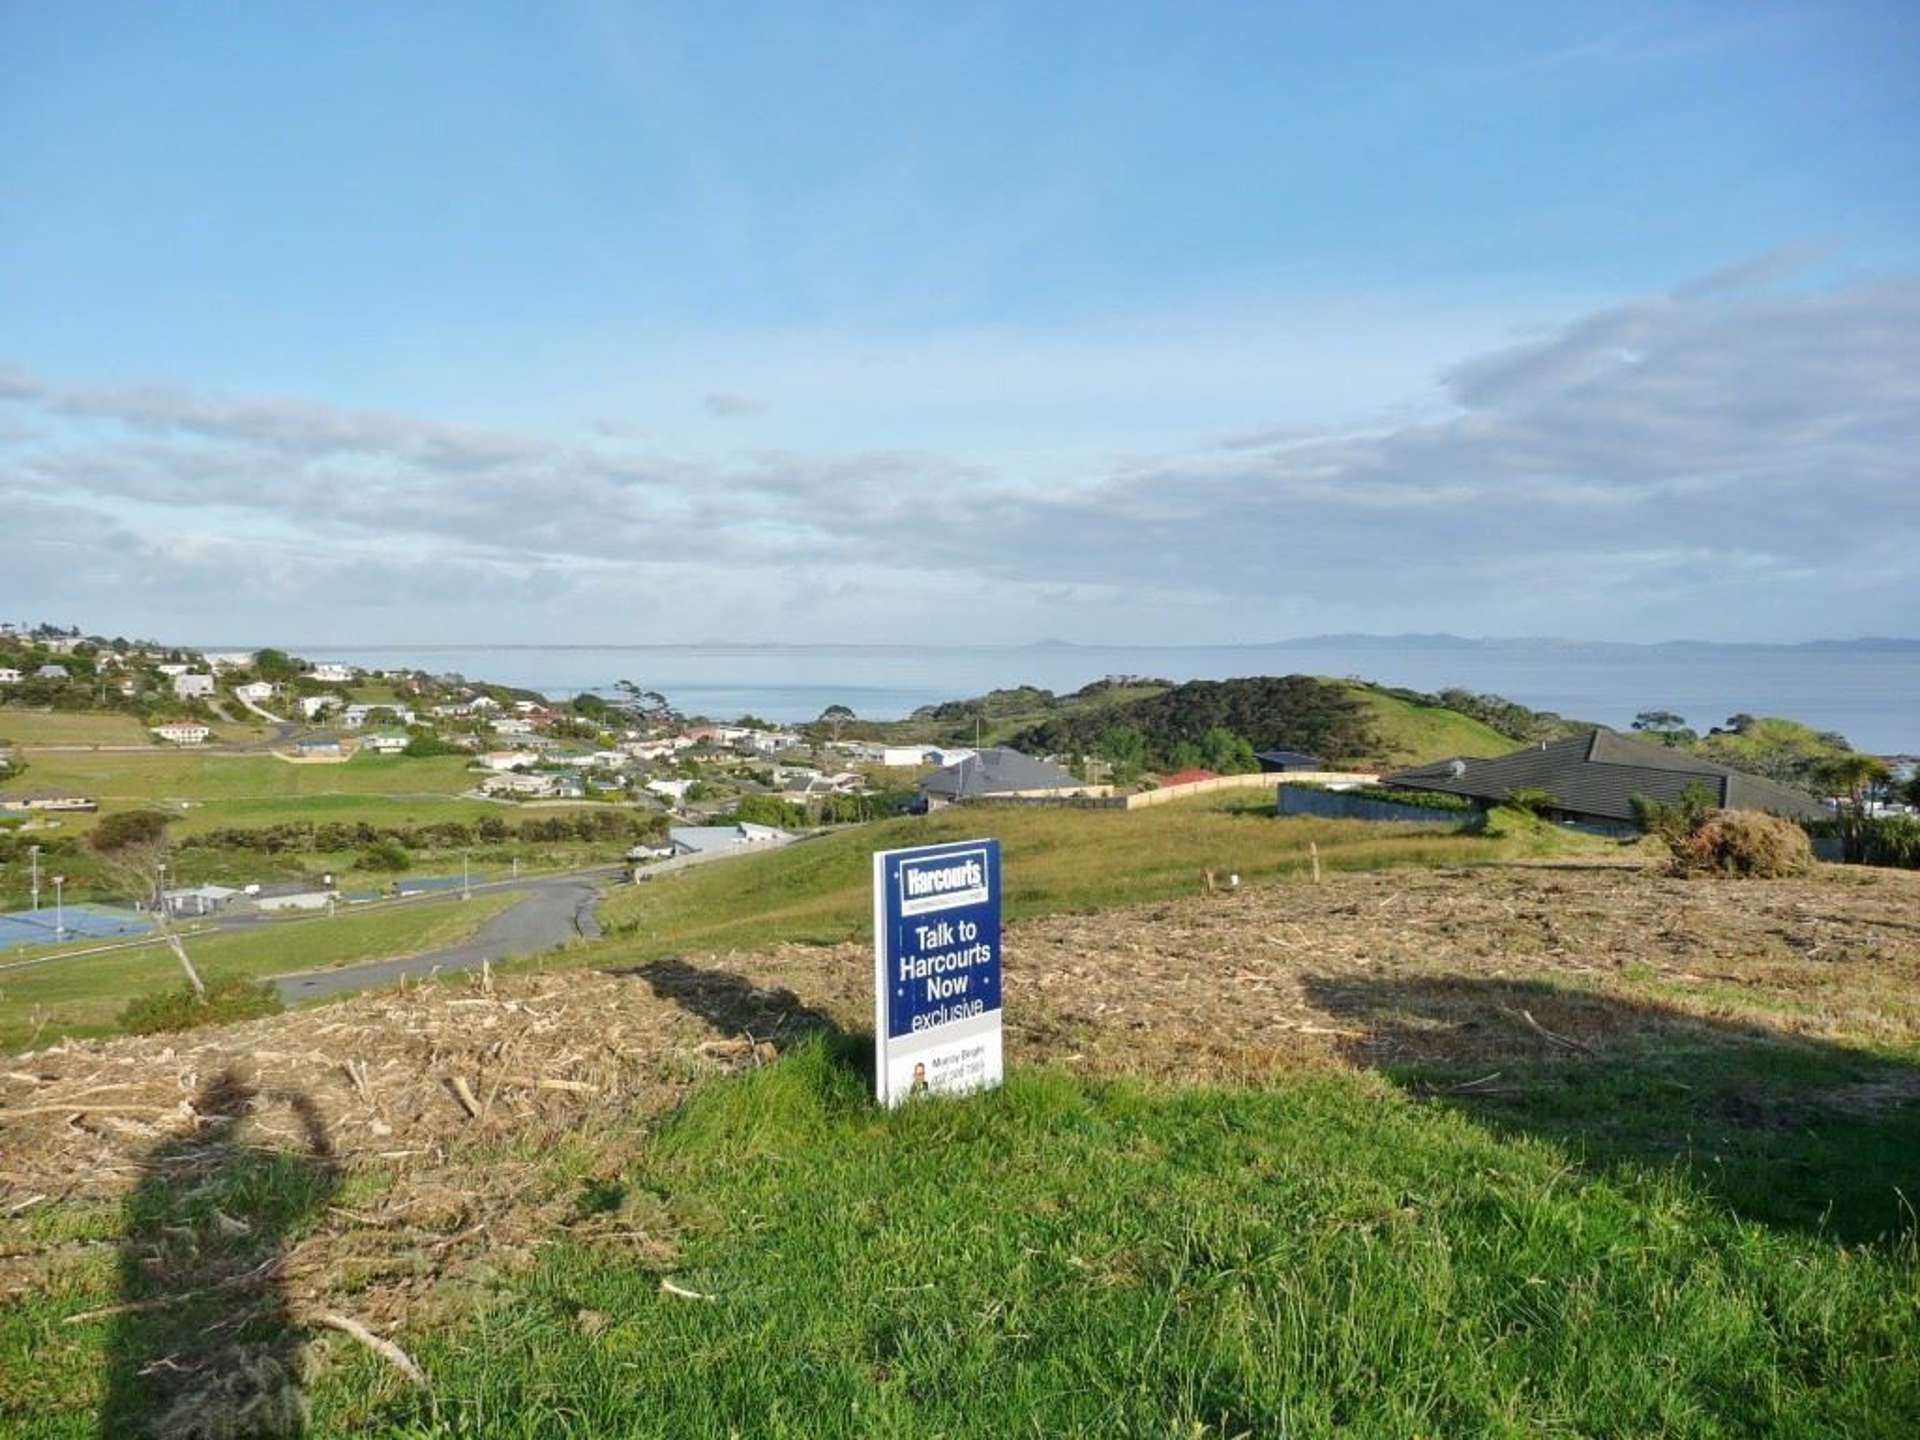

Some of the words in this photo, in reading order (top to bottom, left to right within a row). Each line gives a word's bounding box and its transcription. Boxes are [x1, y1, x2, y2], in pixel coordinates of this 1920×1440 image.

[907, 860, 981, 896] Harcourts
[915, 921, 955, 951] Talk
[958, 920, 977, 942] to
[900, 943, 991, 981] Harcourts
[927, 974, 969, 1002] Now
[911, 997, 984, 1034] exclusive
